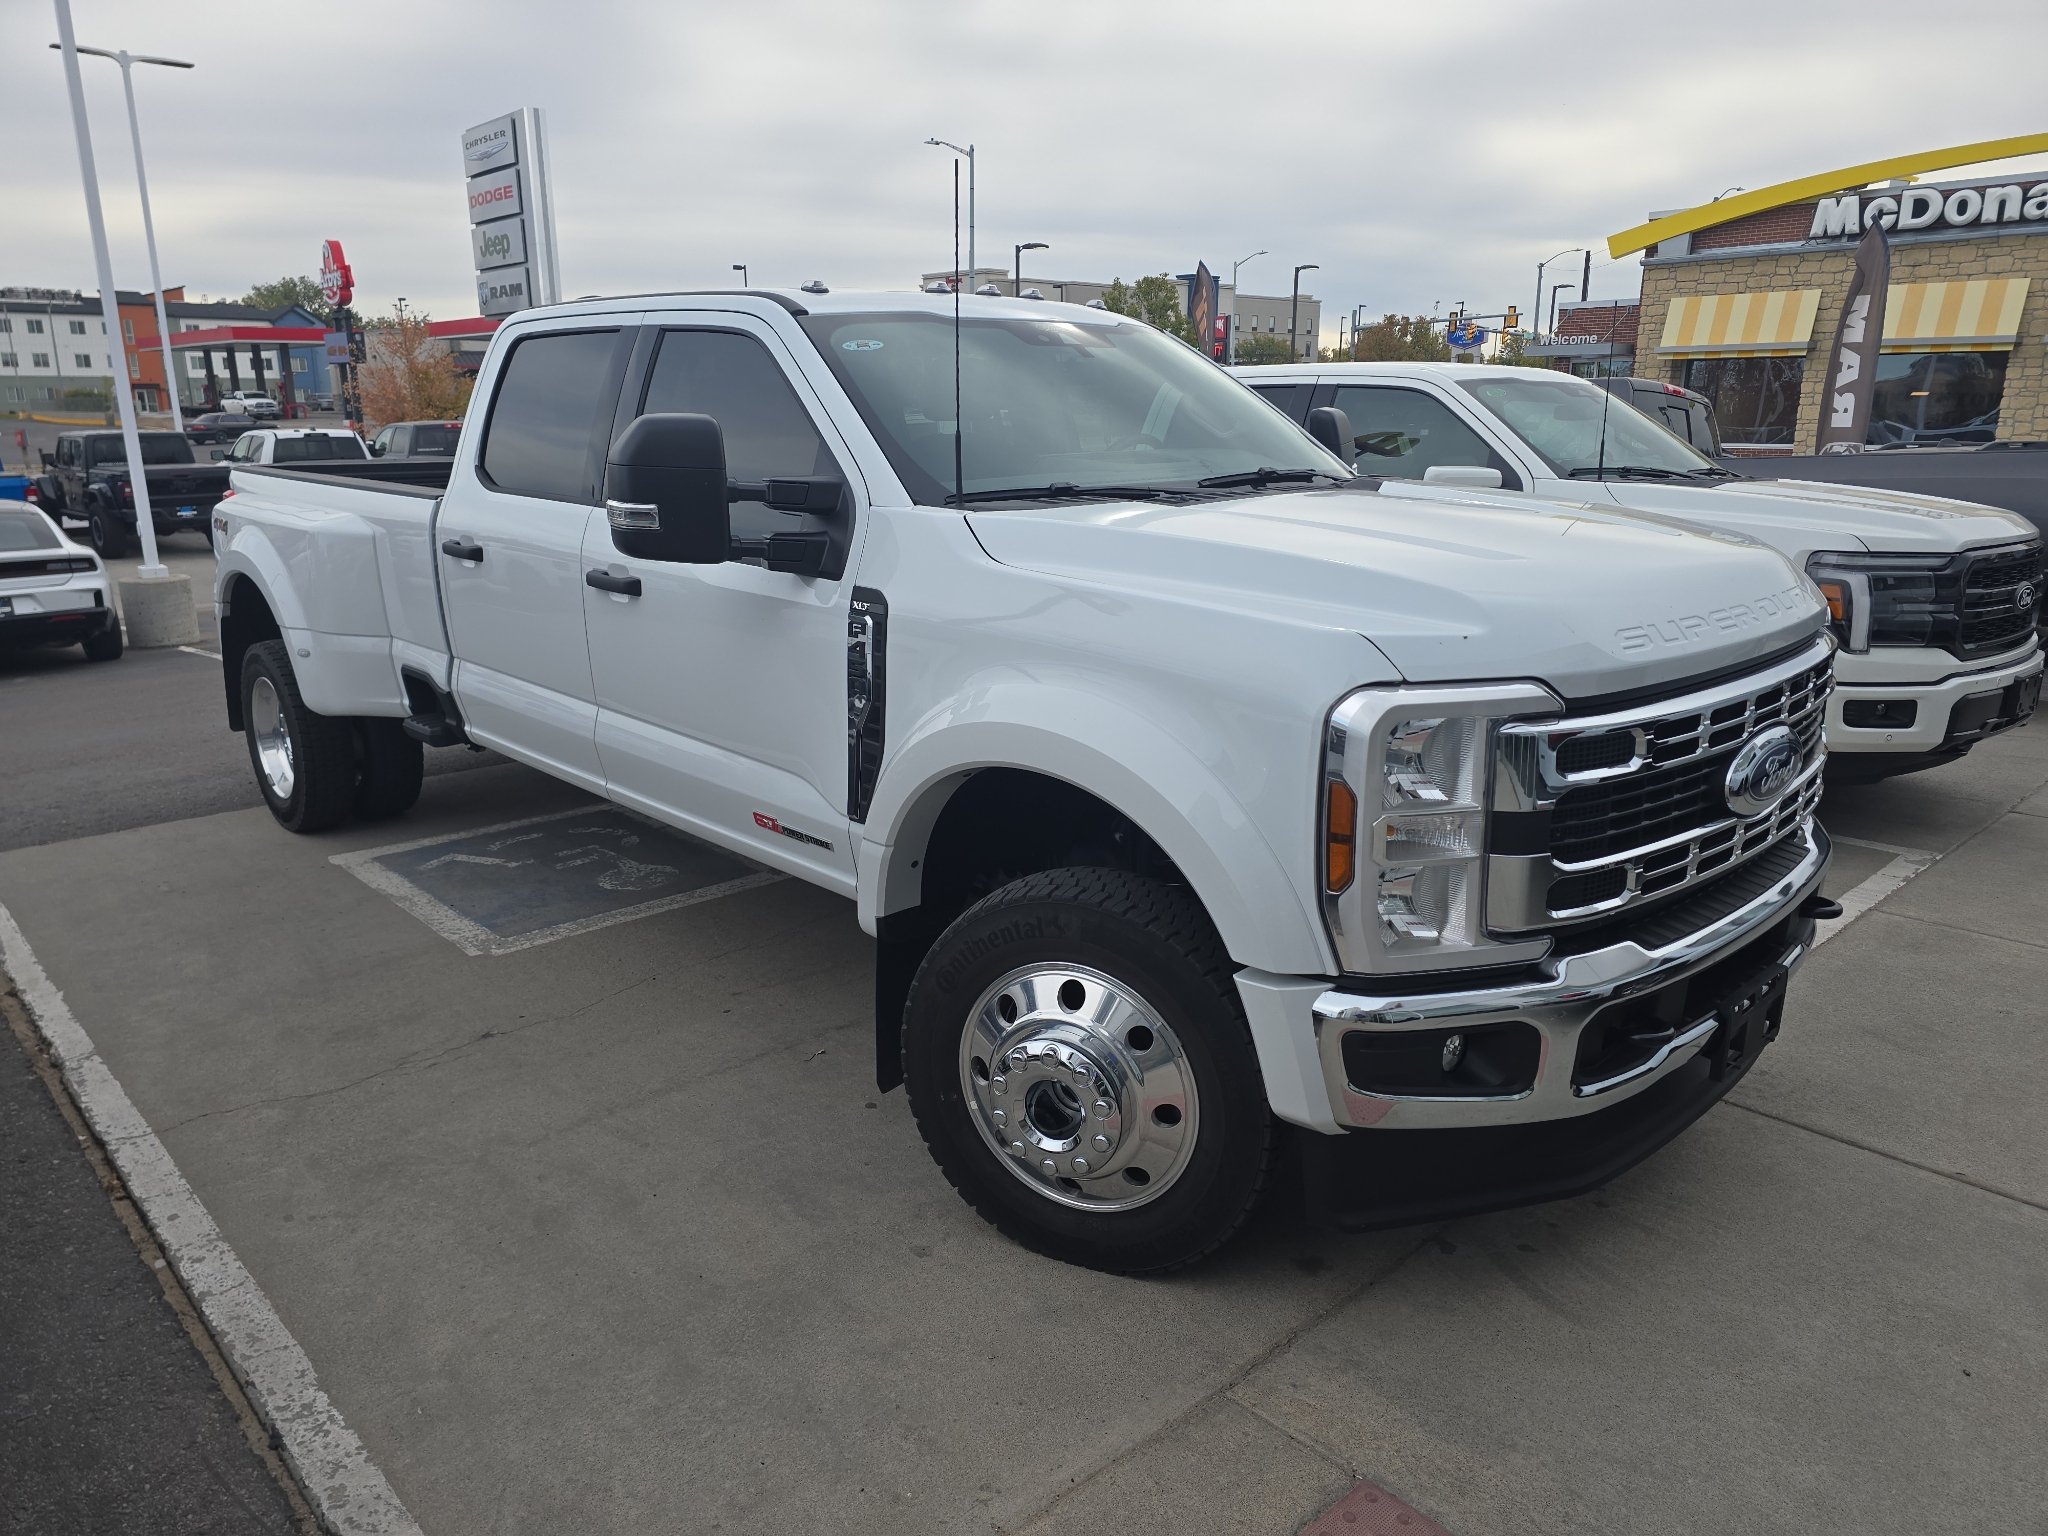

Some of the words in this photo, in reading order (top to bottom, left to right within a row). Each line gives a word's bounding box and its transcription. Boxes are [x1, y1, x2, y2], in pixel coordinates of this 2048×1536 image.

[465, 129, 506, 150] CHRYSLER
[470, 185, 514, 209] DODGE
[479, 230, 511, 260] Jeep
[489, 282, 523, 299] RAM
[1540, 333, 1598, 346] Welcome
[1614, 603, 1760, 654] SUPER
[1761, 751, 1796, 793] Ford
